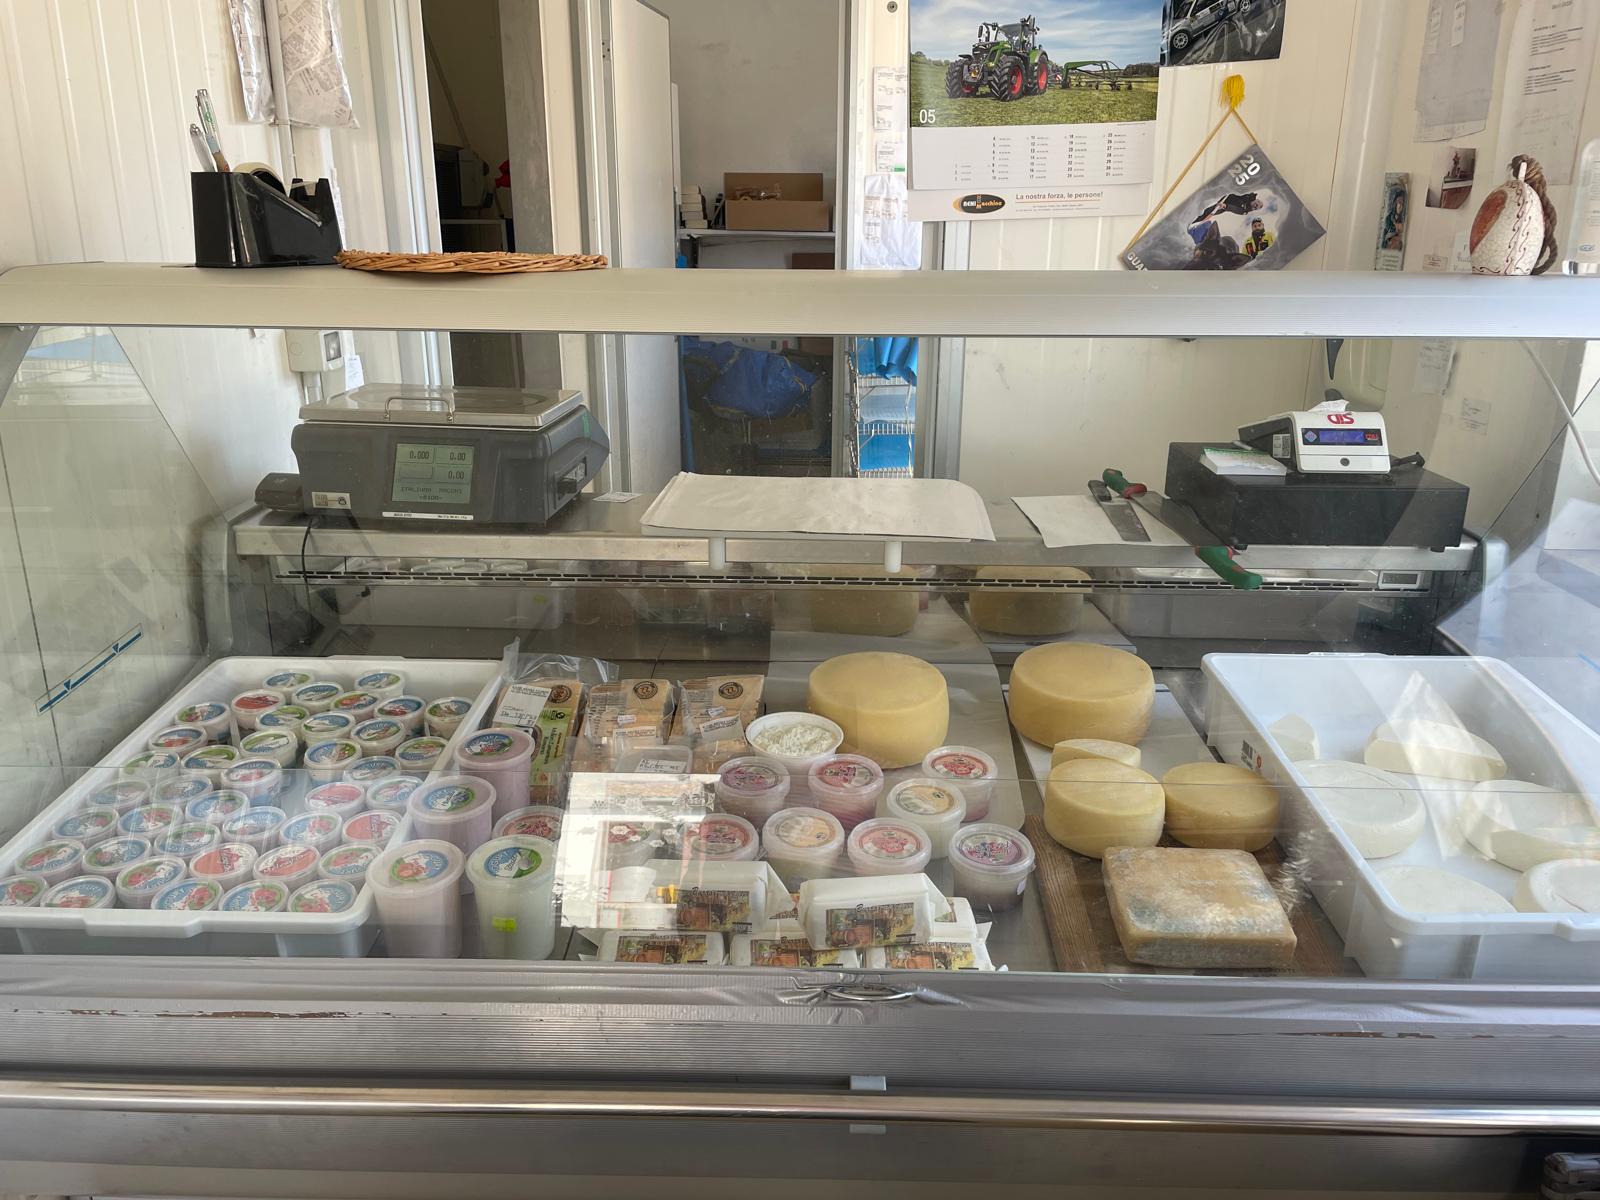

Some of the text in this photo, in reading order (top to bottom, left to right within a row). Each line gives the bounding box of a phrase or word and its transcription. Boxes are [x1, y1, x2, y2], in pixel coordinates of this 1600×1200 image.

[920, 109, 936, 123] 05
[1239, 153, 1261, 176] 20
[1228, 164, 1250, 186] 25
[410, 450, 430, 460] 0.000
[450, 452, 466, 461] 0.00
[448, 470, 465, 480] 0.00
